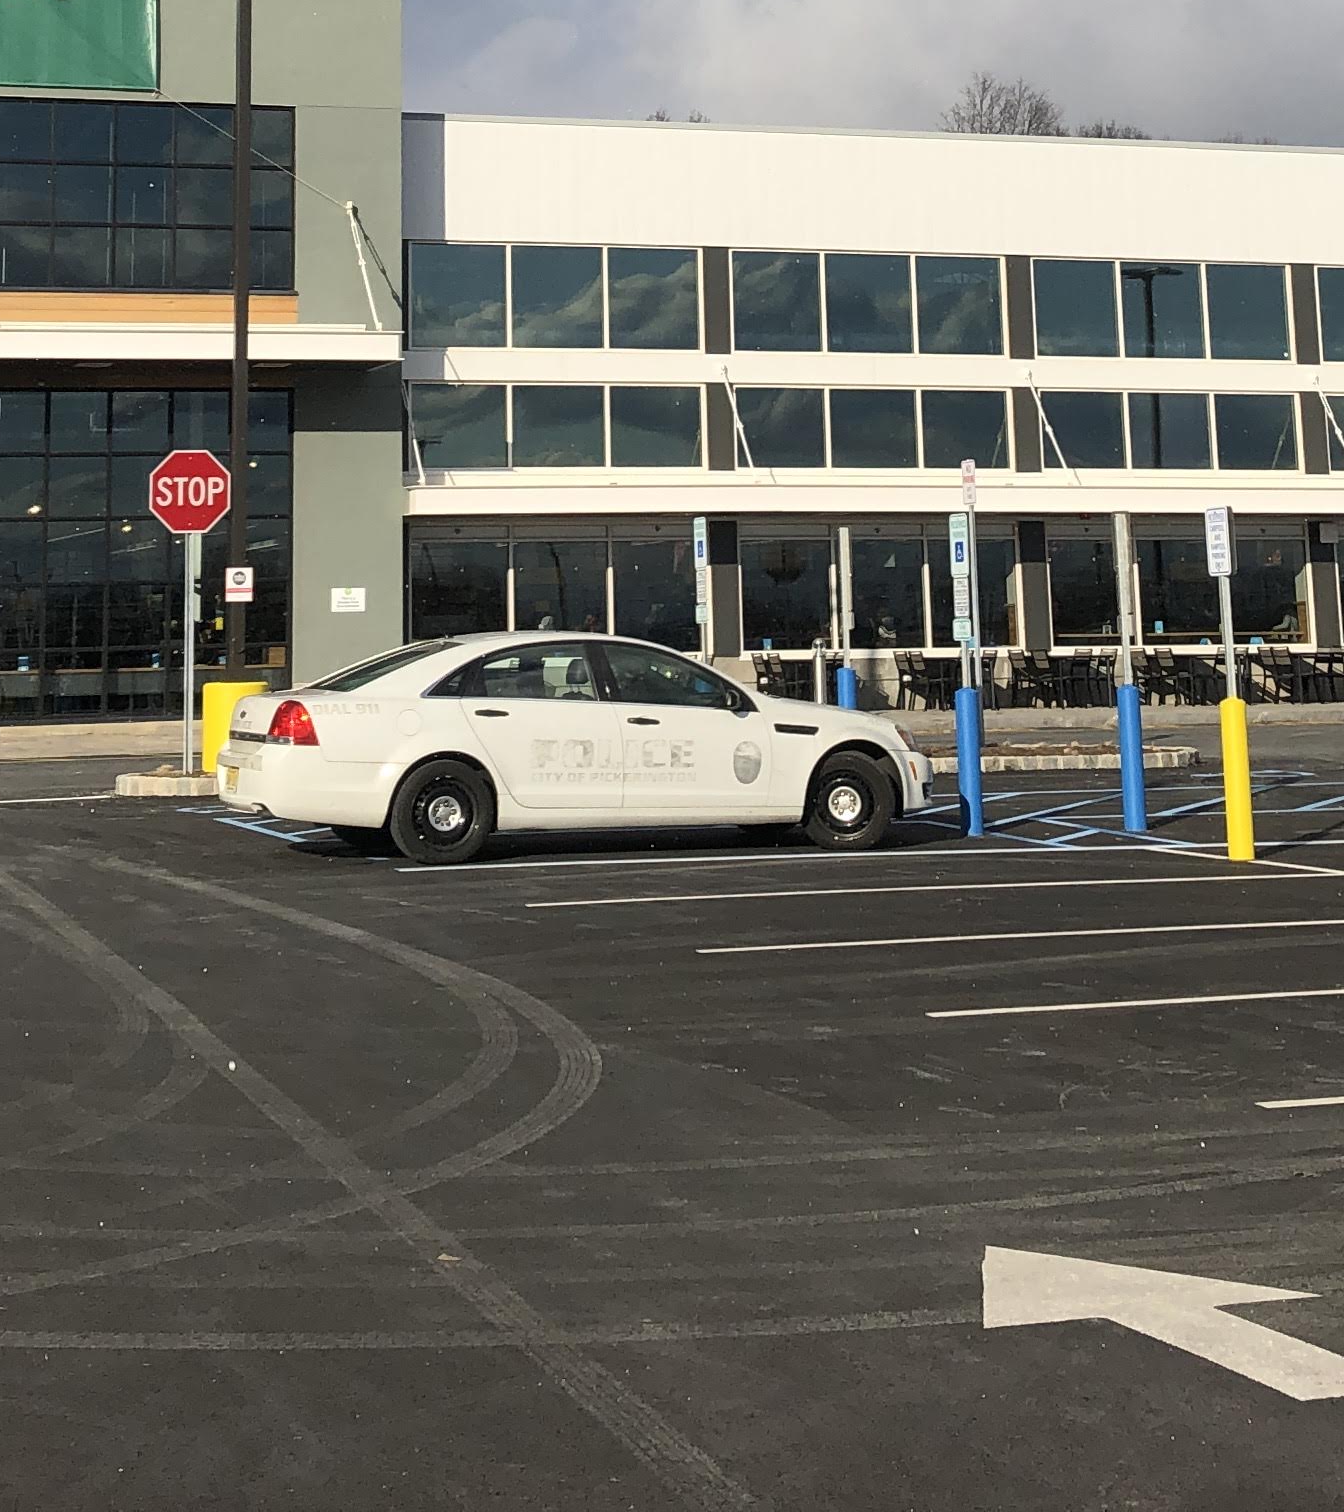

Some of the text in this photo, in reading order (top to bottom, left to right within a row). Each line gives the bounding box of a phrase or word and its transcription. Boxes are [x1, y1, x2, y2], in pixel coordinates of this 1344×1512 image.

[155, 476, 225, 507] STOP
[312, 703, 380, 715] DIAL 911
[530, 739, 695, 768] POLICE
[531, 772, 563, 783] CITY
[567, 772, 585, 783] OF
